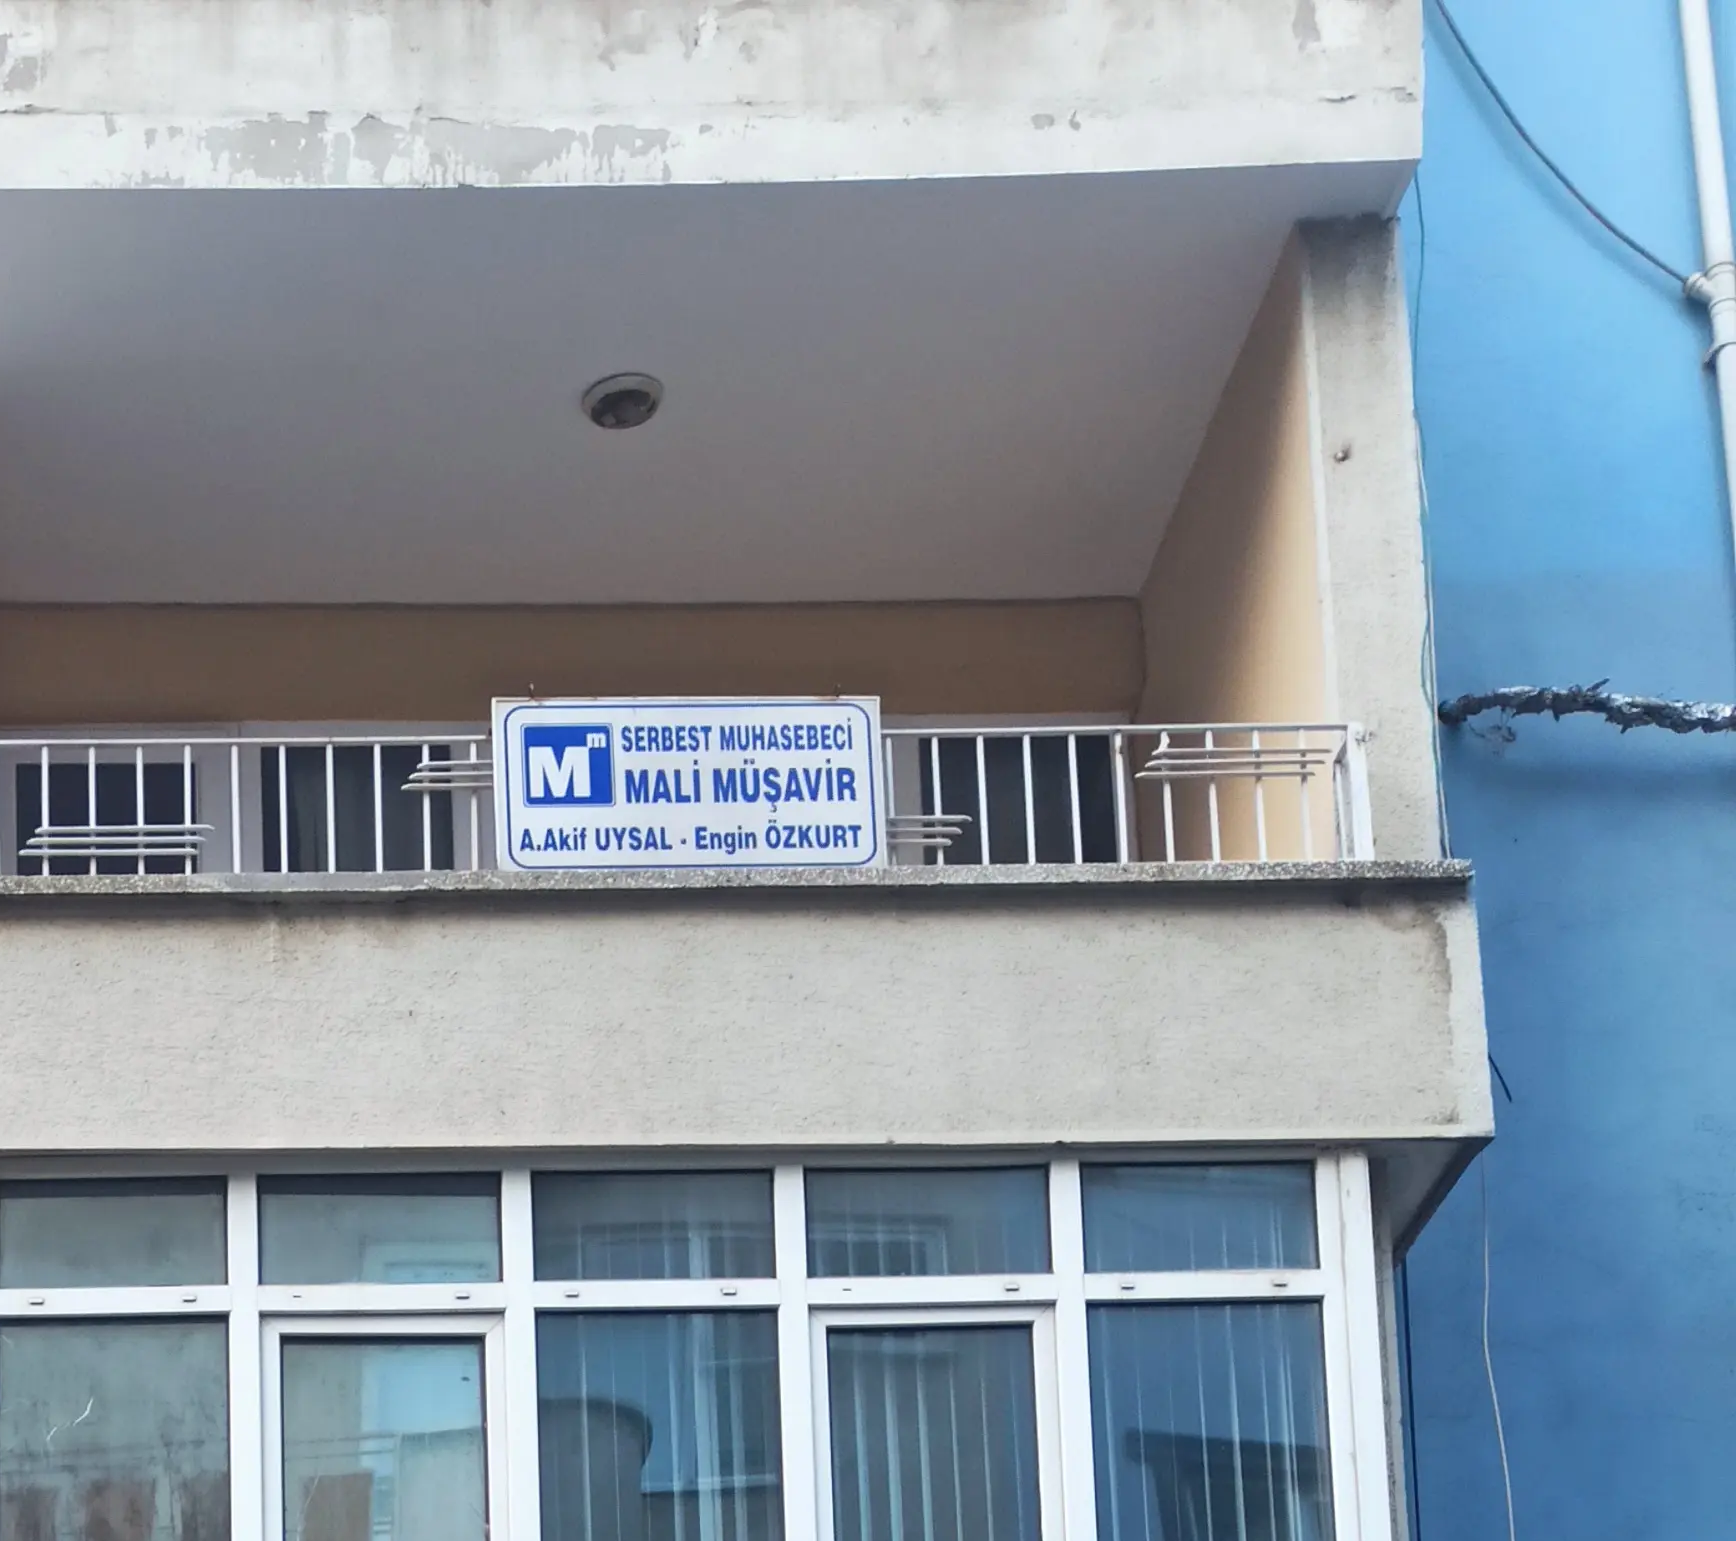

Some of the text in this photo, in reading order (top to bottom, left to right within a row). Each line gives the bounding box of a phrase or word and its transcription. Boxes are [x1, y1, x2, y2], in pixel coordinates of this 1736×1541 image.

[620, 717, 854, 753] SERBEST MUHASEBECİ
[624, 757, 857, 813] MALİ MÜŞAVİR
[519, 818, 862, 855] A.Akif UYSAL Engin ÖZKURT
